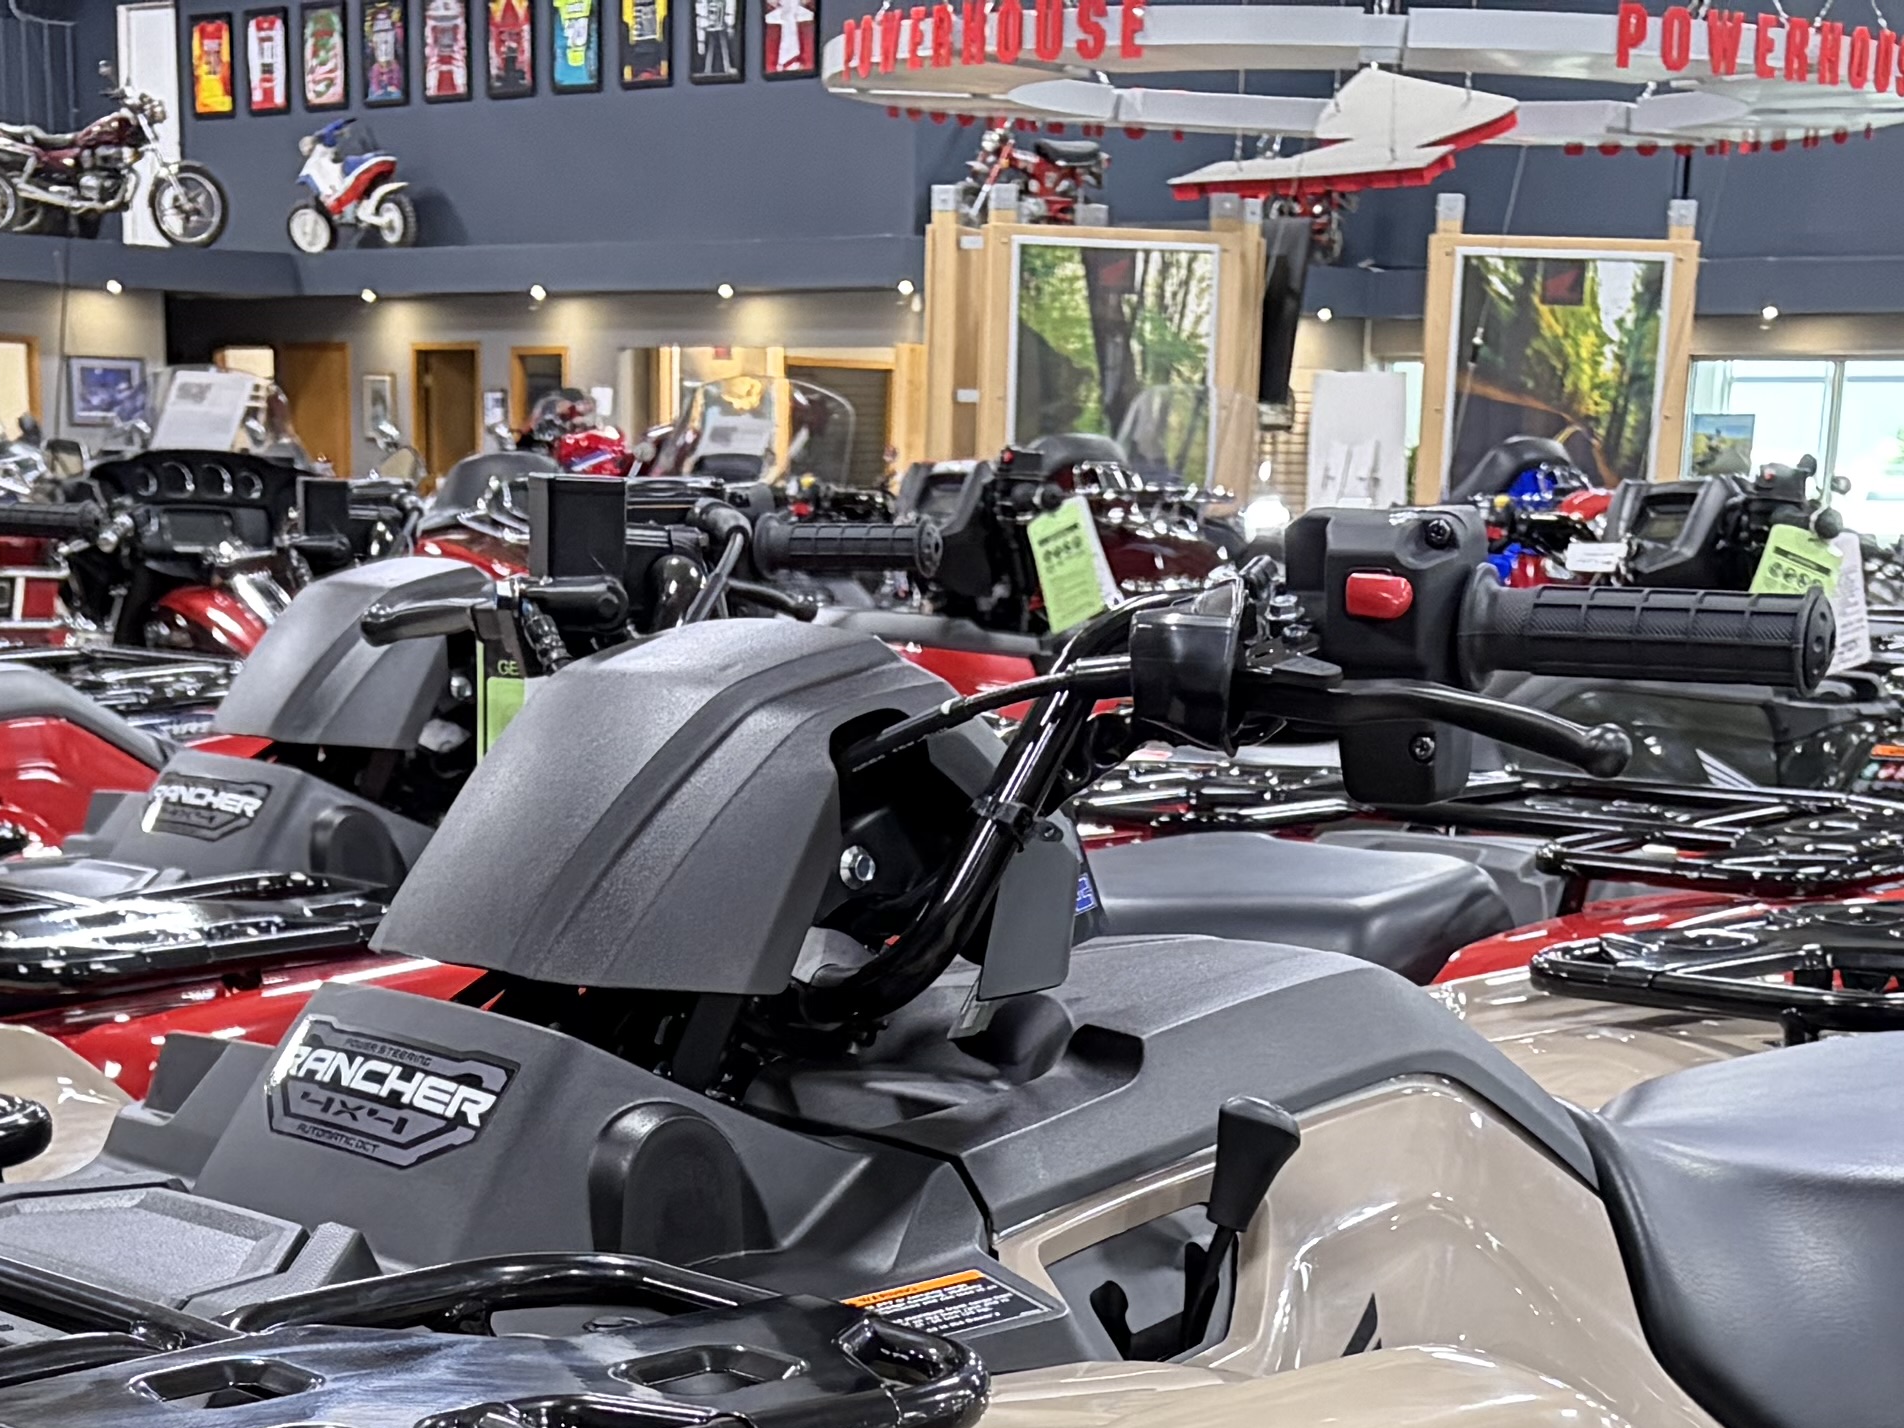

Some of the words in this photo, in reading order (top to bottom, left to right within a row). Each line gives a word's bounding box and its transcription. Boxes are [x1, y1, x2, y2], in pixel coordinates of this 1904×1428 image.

[841, 0, 1145, 81] POWERHOUSE
[154, 784, 263, 818] RANCHER
[345, 1037, 377, 1052] POWER
[378, 1042, 433, 1068] STEERING
[288, 1044, 497, 1128] RANCHER
[296, 1122, 354, 1147] AUTOMATIC
[354, 1136, 381, 1155] DCT
